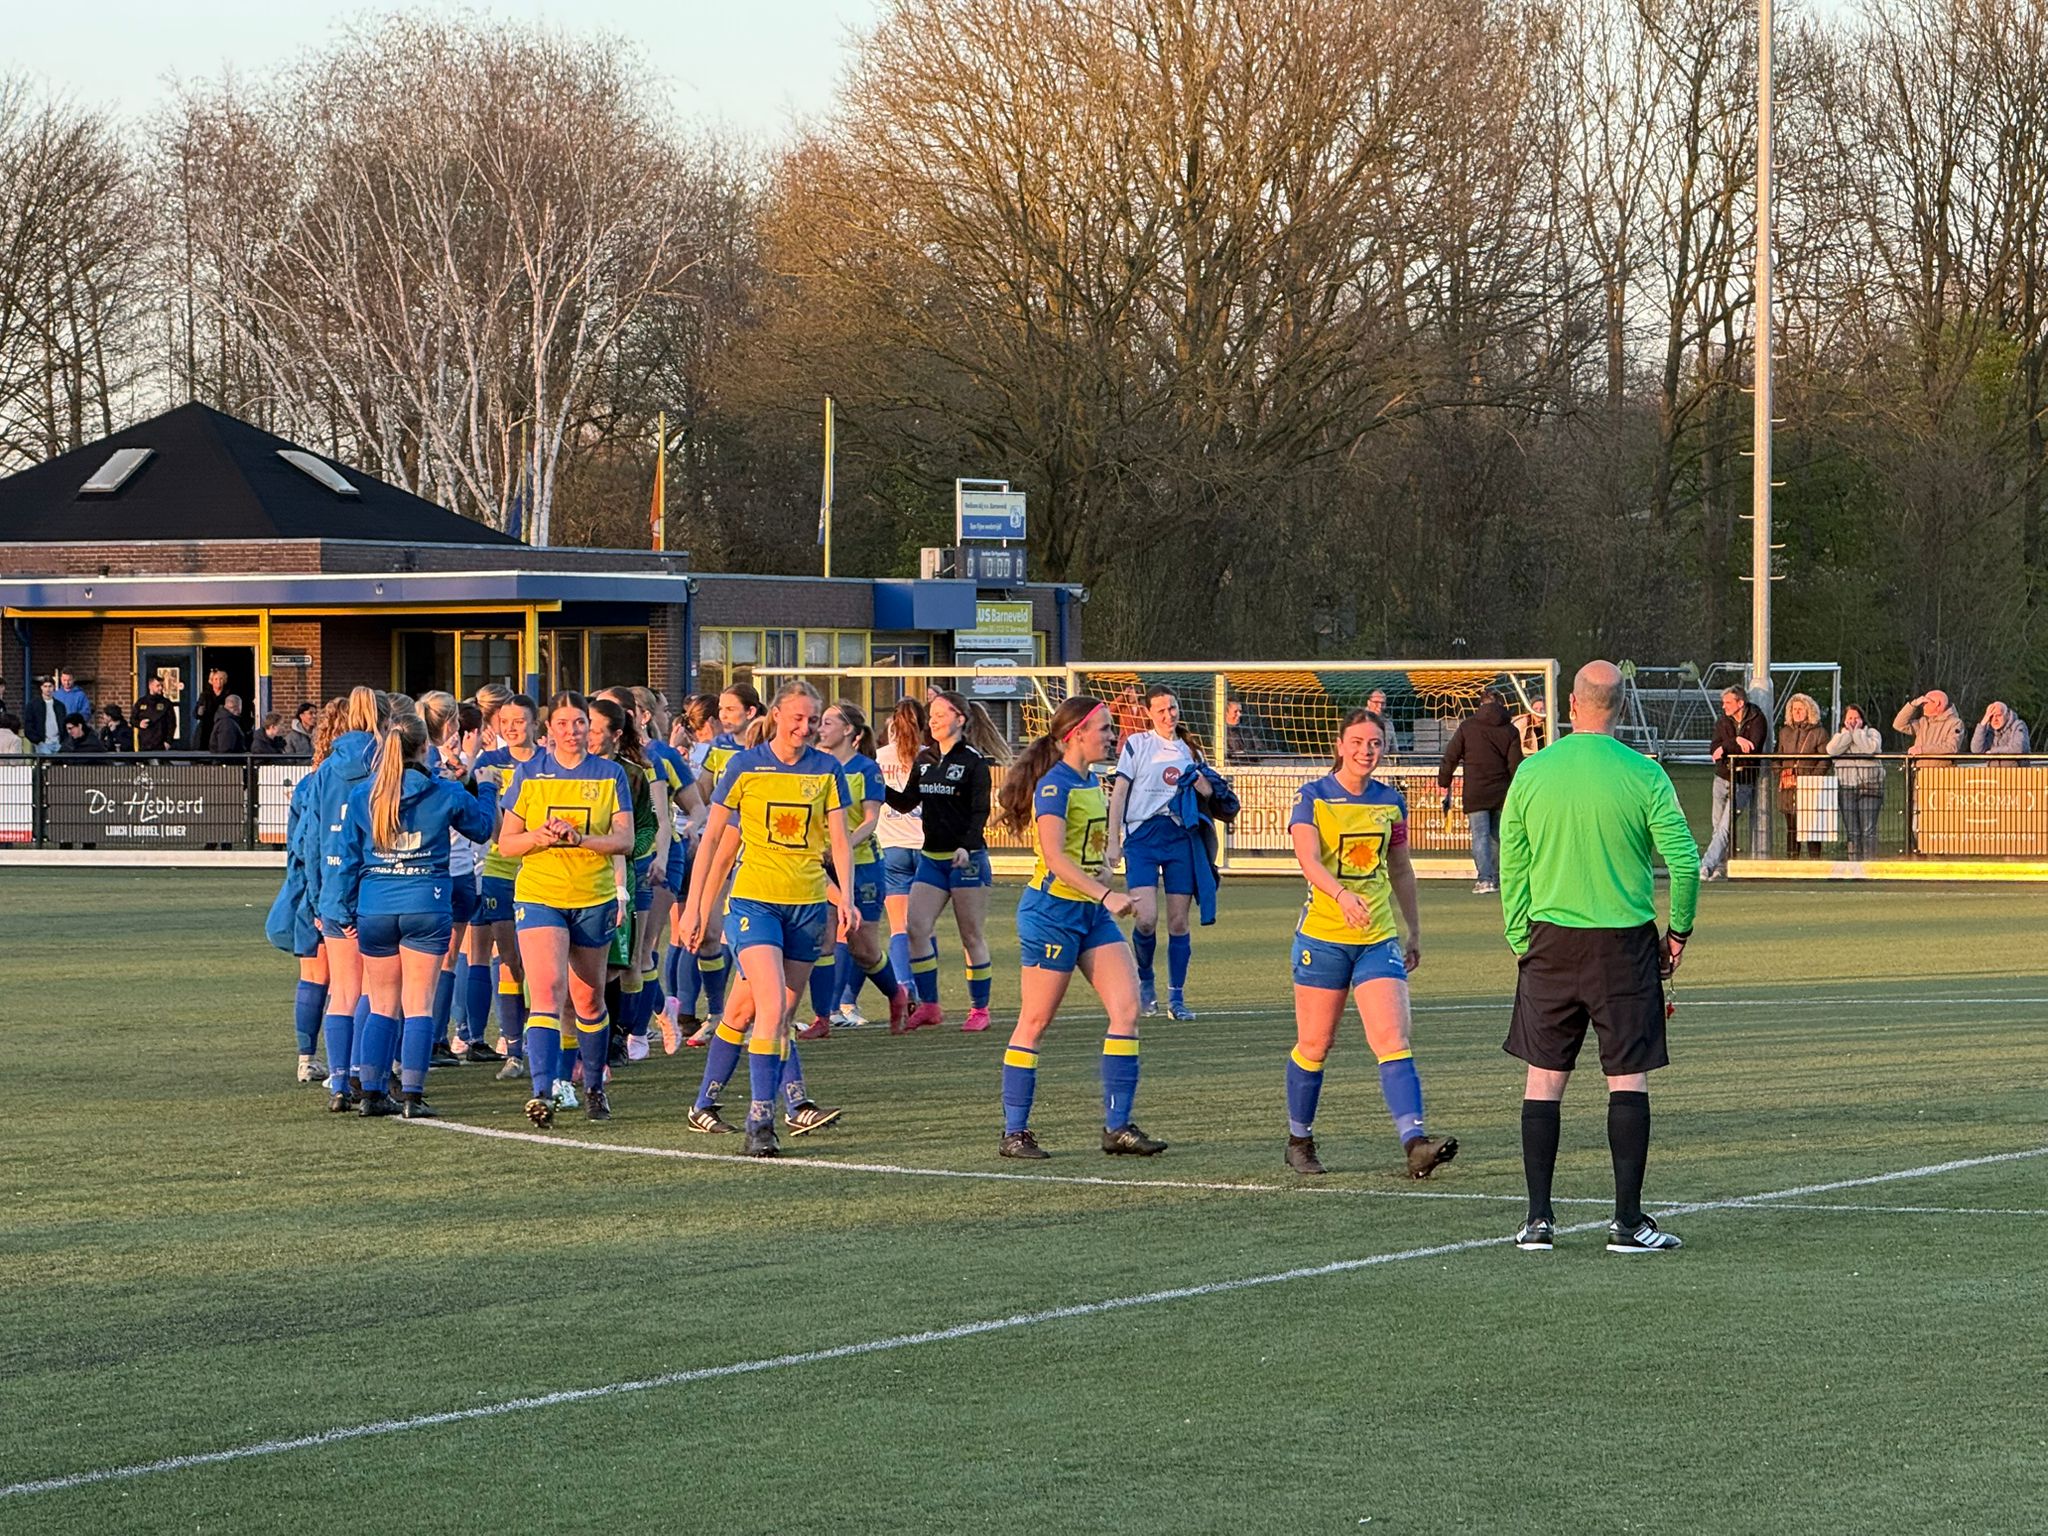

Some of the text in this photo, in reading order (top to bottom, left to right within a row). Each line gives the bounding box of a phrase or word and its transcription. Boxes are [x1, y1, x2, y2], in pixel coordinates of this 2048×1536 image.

[976, 608, 1029, 622] US Barneveld
[85, 788, 204, 823] De Hebberd
[105, 825, 186, 836] LUNCH BORREL DINER
[486, 897, 497, 910] 10
[740, 916, 749, 931] 2
[1045, 943, 1062, 960] 17
[1301, 949, 1312, 966] 3
